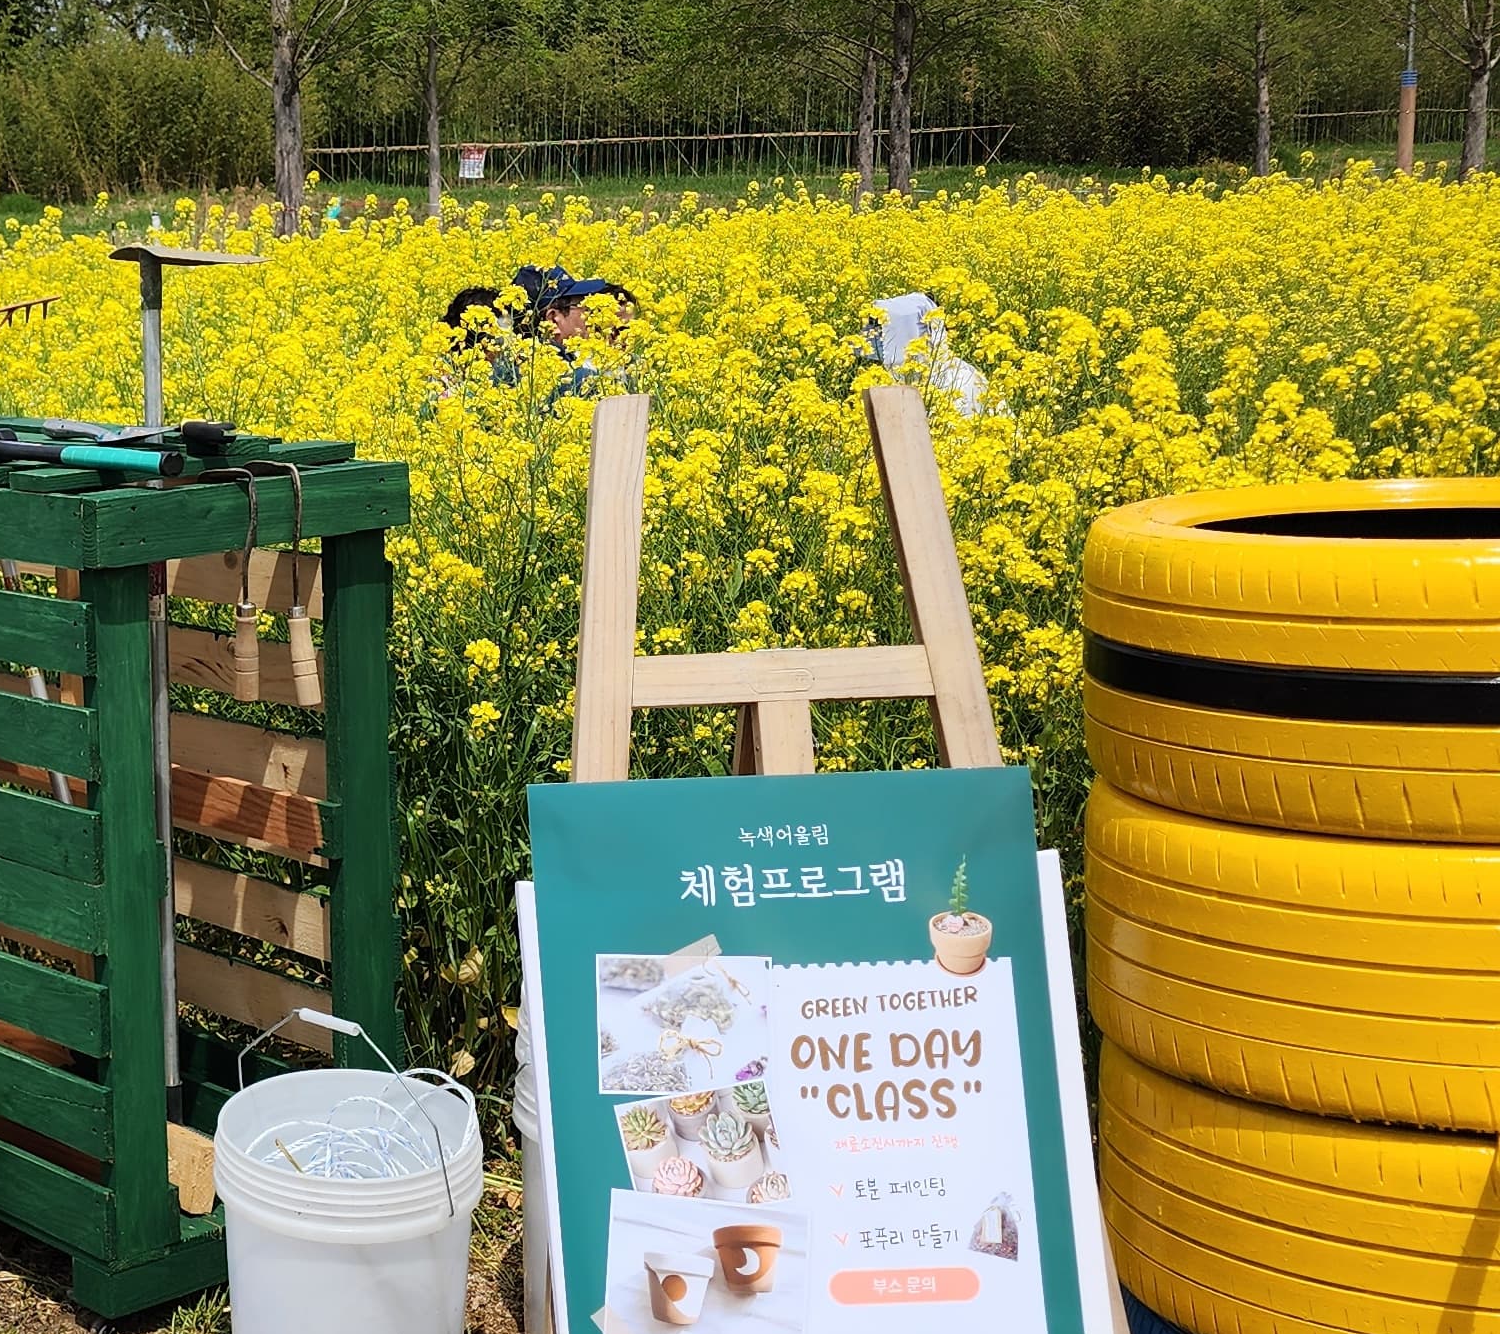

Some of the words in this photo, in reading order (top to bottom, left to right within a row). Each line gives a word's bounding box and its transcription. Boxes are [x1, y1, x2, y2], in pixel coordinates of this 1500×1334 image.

[738, 823, 829, 848] 녹색어울림
[679, 858, 907, 908] 체험프로그램
[801, 995, 869, 1020] GREEN
[875, 985, 978, 1012] TOGETHER
[790, 1032, 874, 1073] ONE
[888, 1028, 982, 1070] DAY
[800, 1077, 982, 1122] "CLASS"
[855, 1177, 881, 1201] 토분
[888, 1176, 947, 1198] 페인팅
[859, 1226, 905, 1251] 포푸리
[912, 1223, 958, 1250] 만들기
[872, 1277, 903, 1296] 부스
[907, 1275, 937, 1294] 문의
